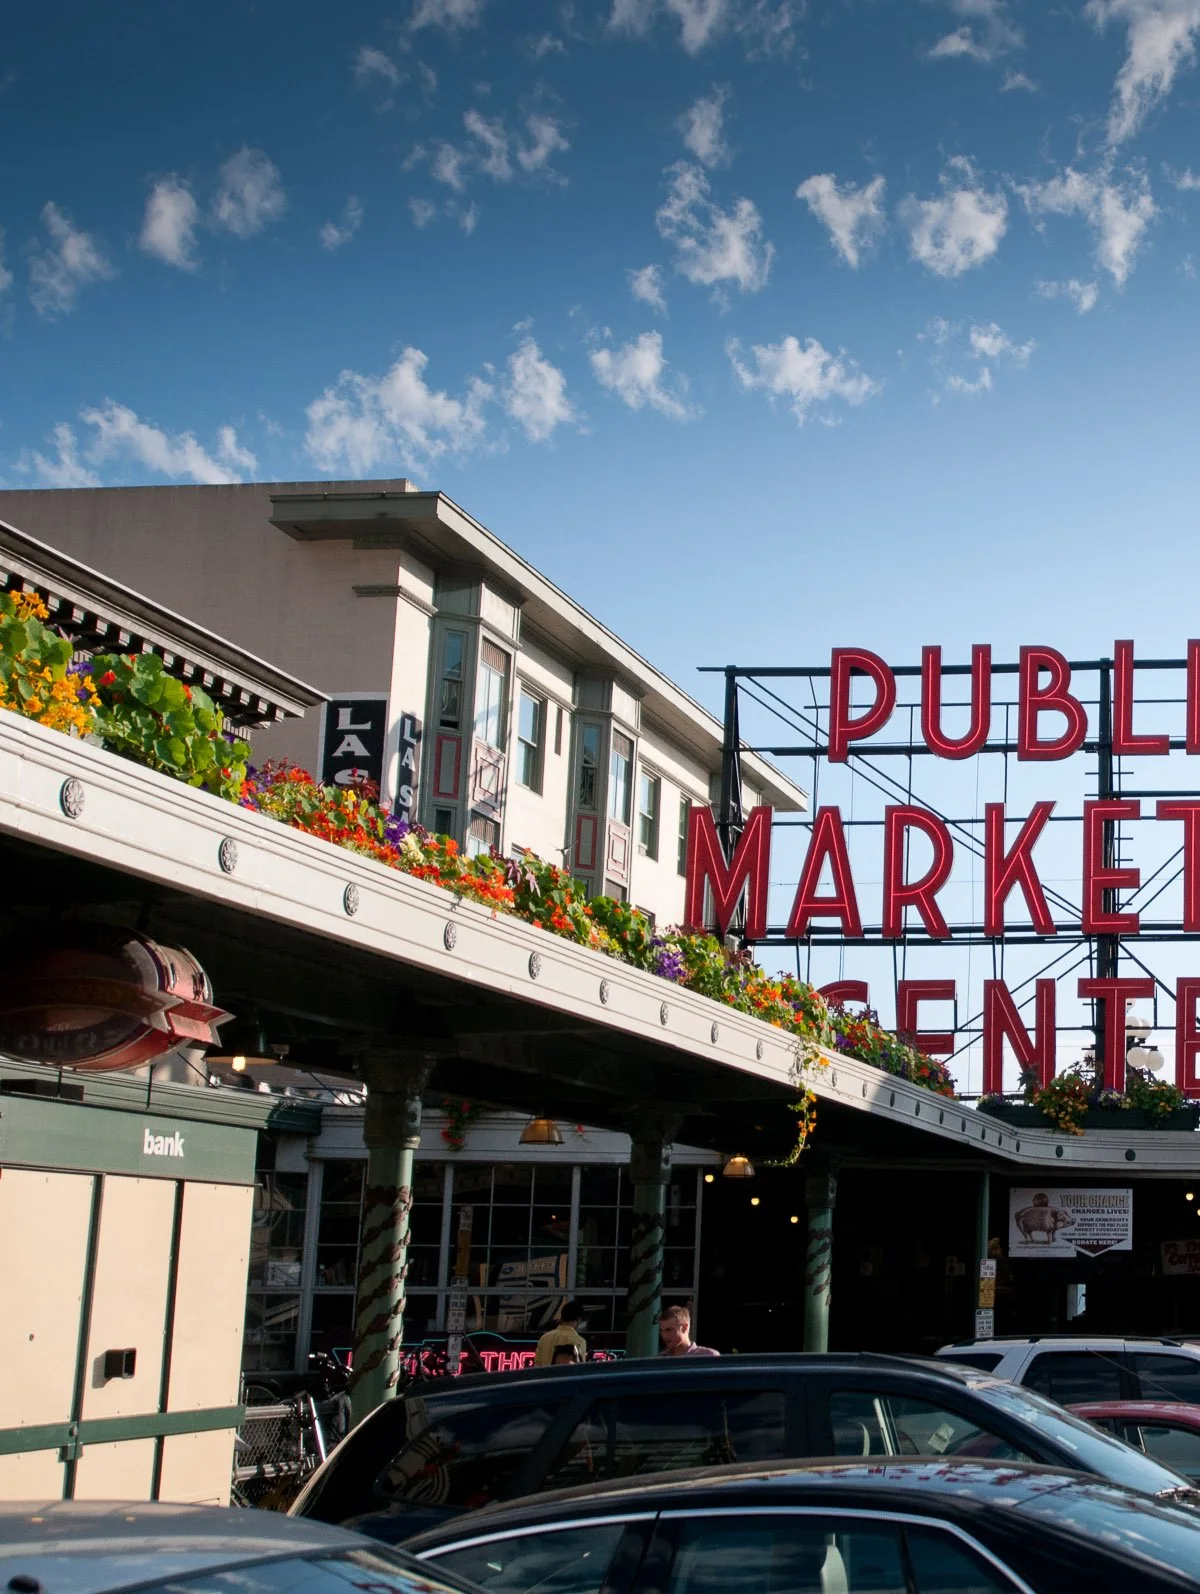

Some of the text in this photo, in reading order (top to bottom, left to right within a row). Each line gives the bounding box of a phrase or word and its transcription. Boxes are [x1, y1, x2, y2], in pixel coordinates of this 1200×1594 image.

[143, 1128, 185, 1157] bank
[1060, 1195, 1129, 1208] YOUR CHANGE
